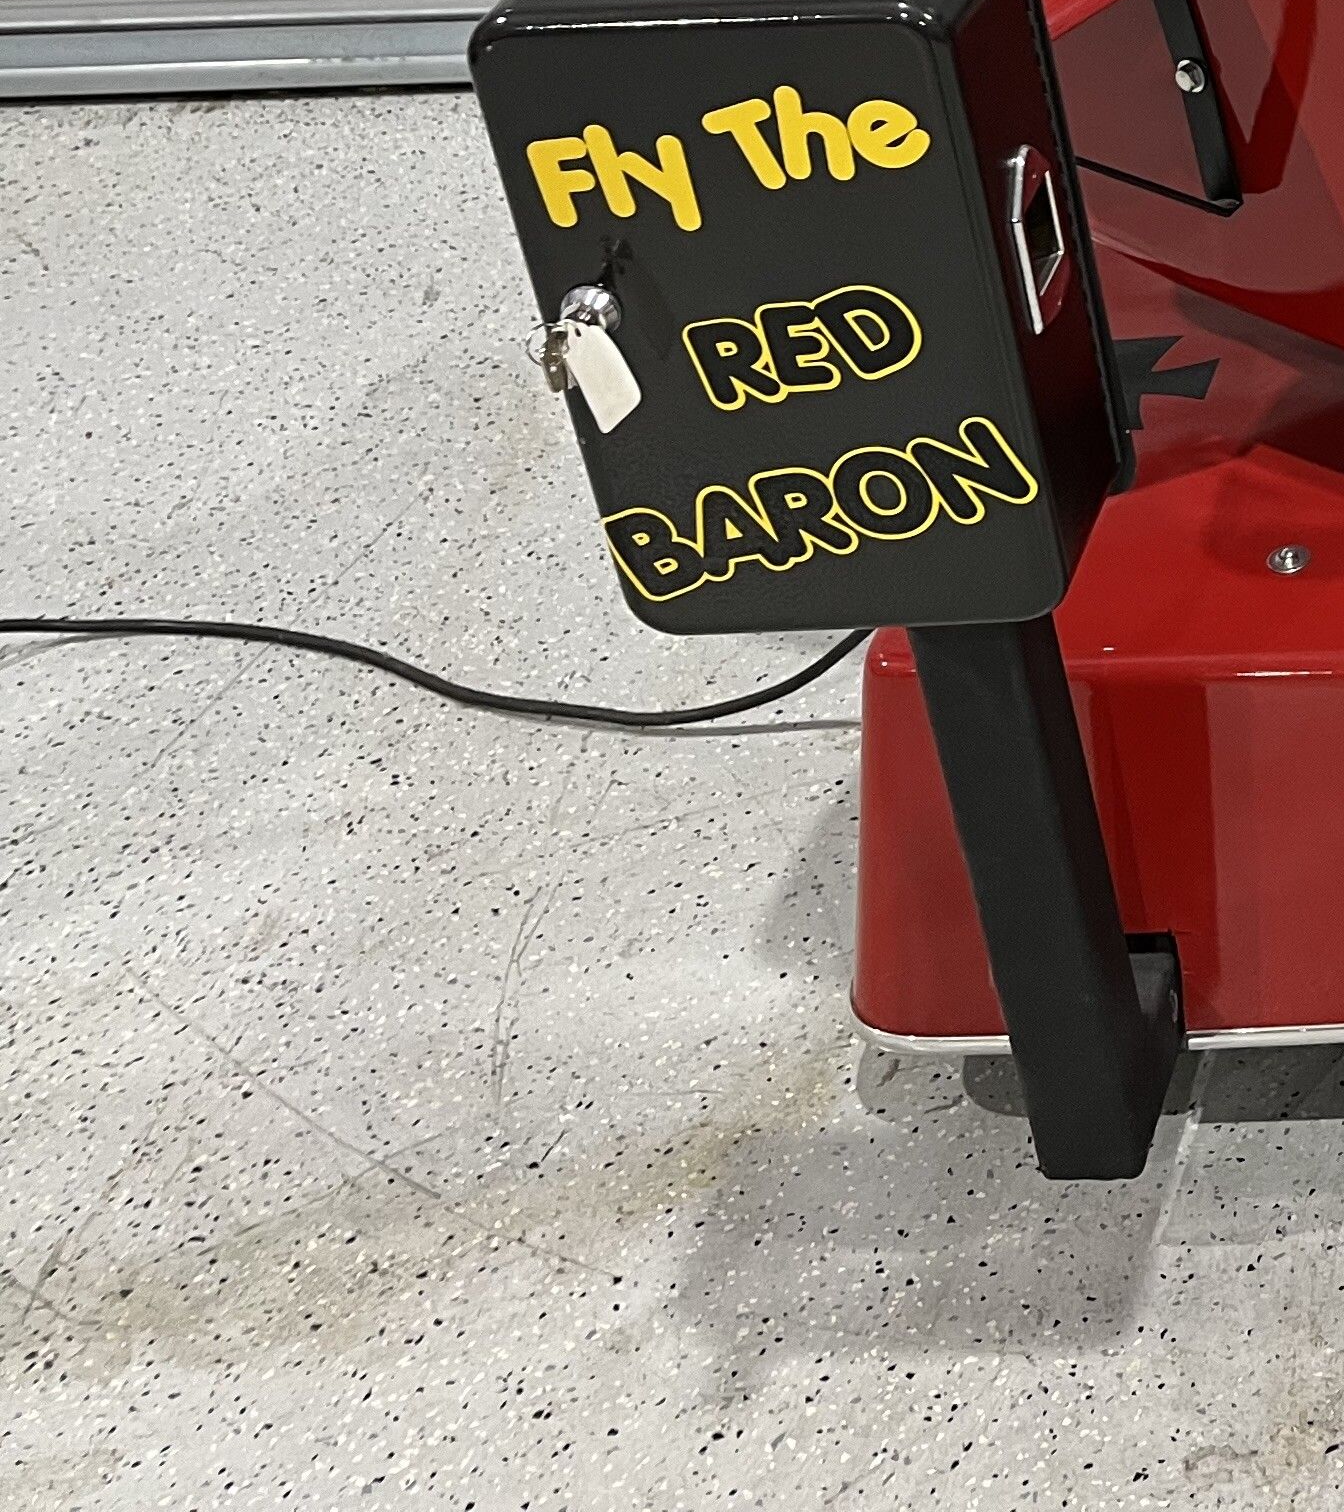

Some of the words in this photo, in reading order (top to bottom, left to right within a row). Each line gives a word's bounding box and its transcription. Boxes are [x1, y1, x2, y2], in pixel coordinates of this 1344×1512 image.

[526, 124, 702, 232] Fly
[702, 85, 931, 190] The
[682, 285, 922, 412] RED
[603, 416, 1039, 602] BARON
